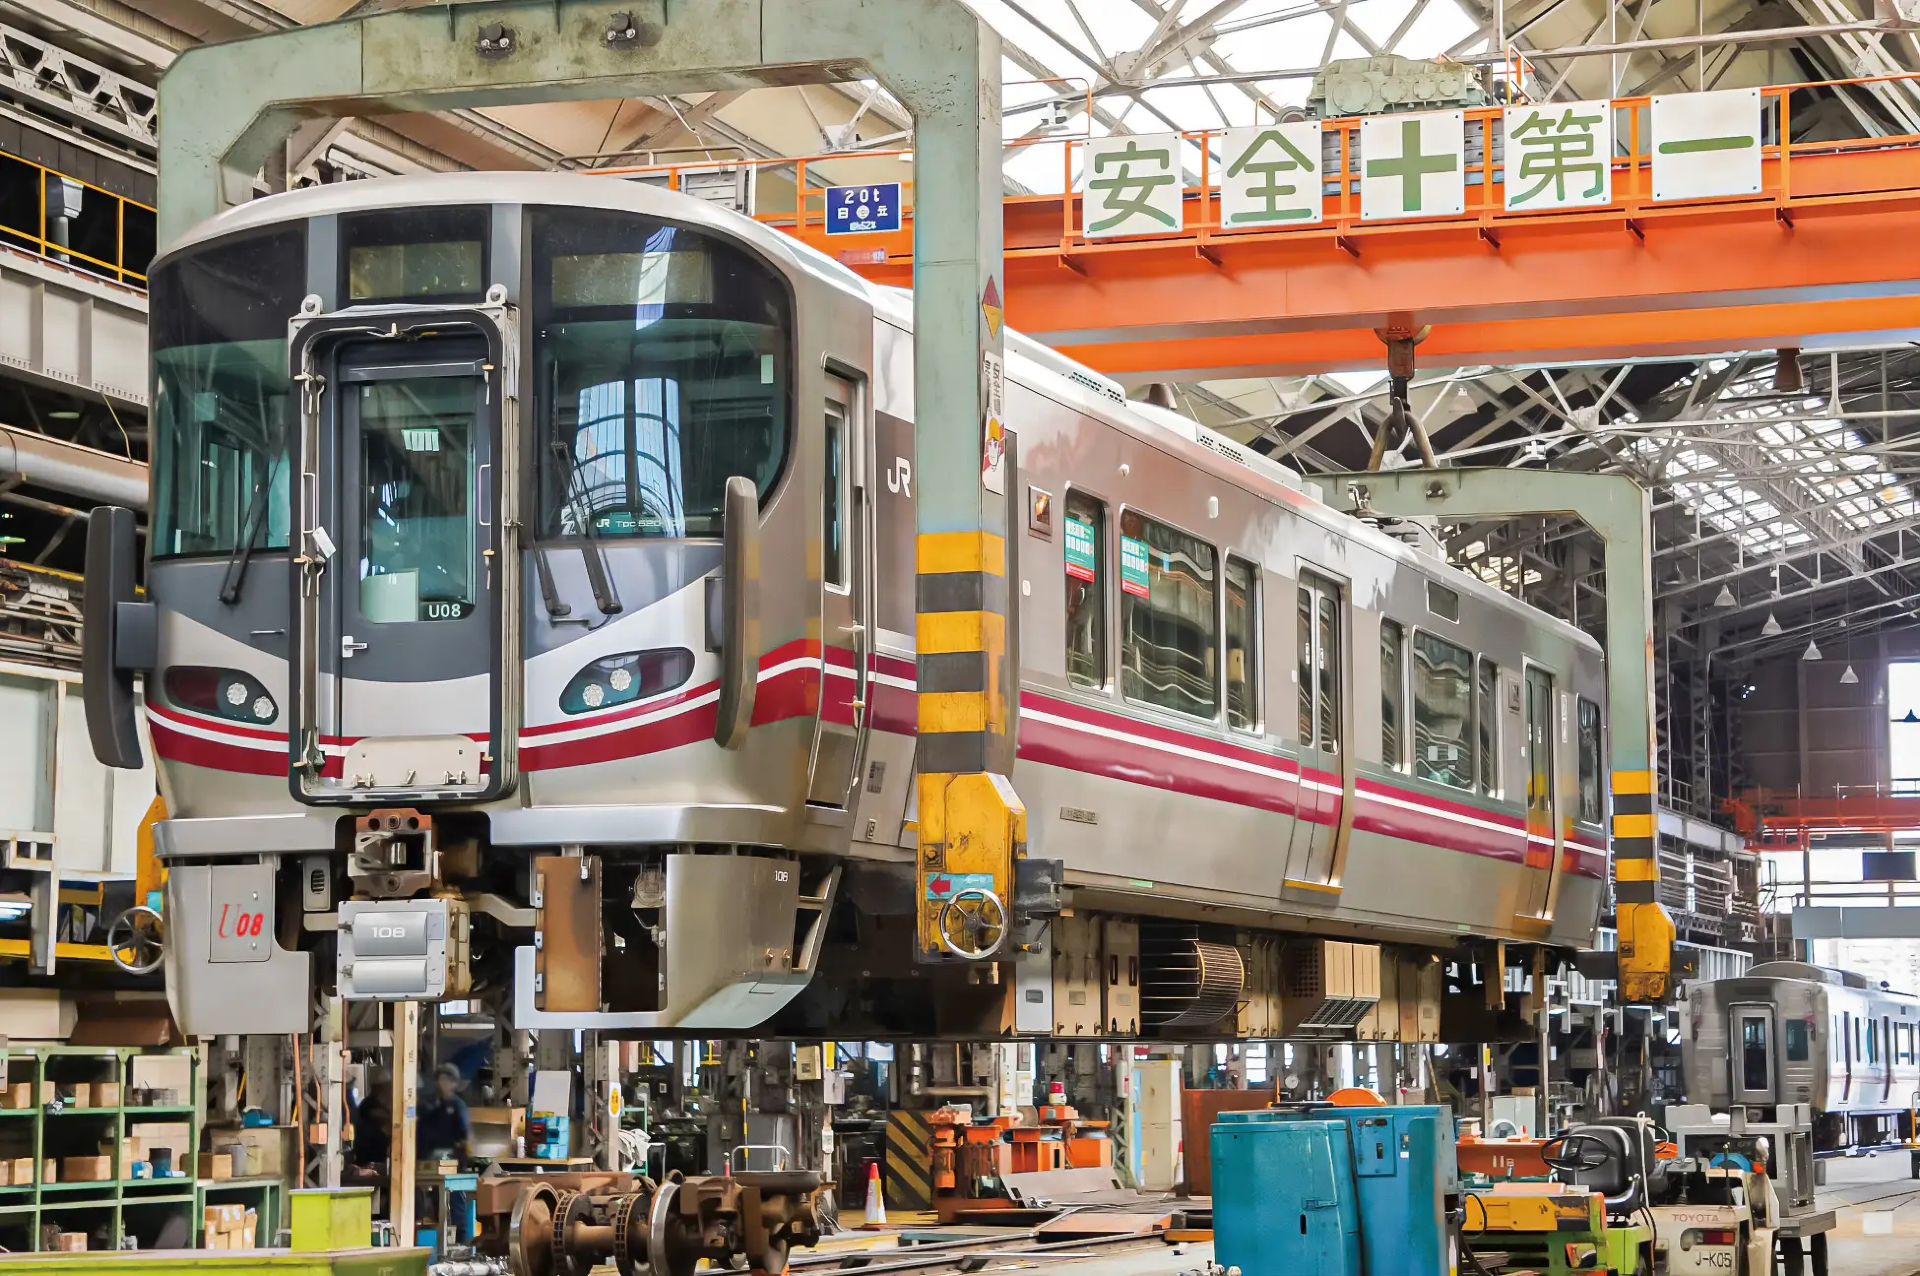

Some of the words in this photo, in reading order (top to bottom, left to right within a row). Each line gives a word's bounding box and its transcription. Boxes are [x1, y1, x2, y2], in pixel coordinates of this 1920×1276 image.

[844, 188, 880, 205] 20t
[887, 456, 911, 498] JR
[596, 518, 610, 528] JR
[428, 603, 461, 618] U08
[774, 870, 789, 882] 108
[372, 927, 405, 938] 108
[1671, 1213, 1719, 1223] TOYOTA
[1695, 1251, 1733, 1268] J-K05
